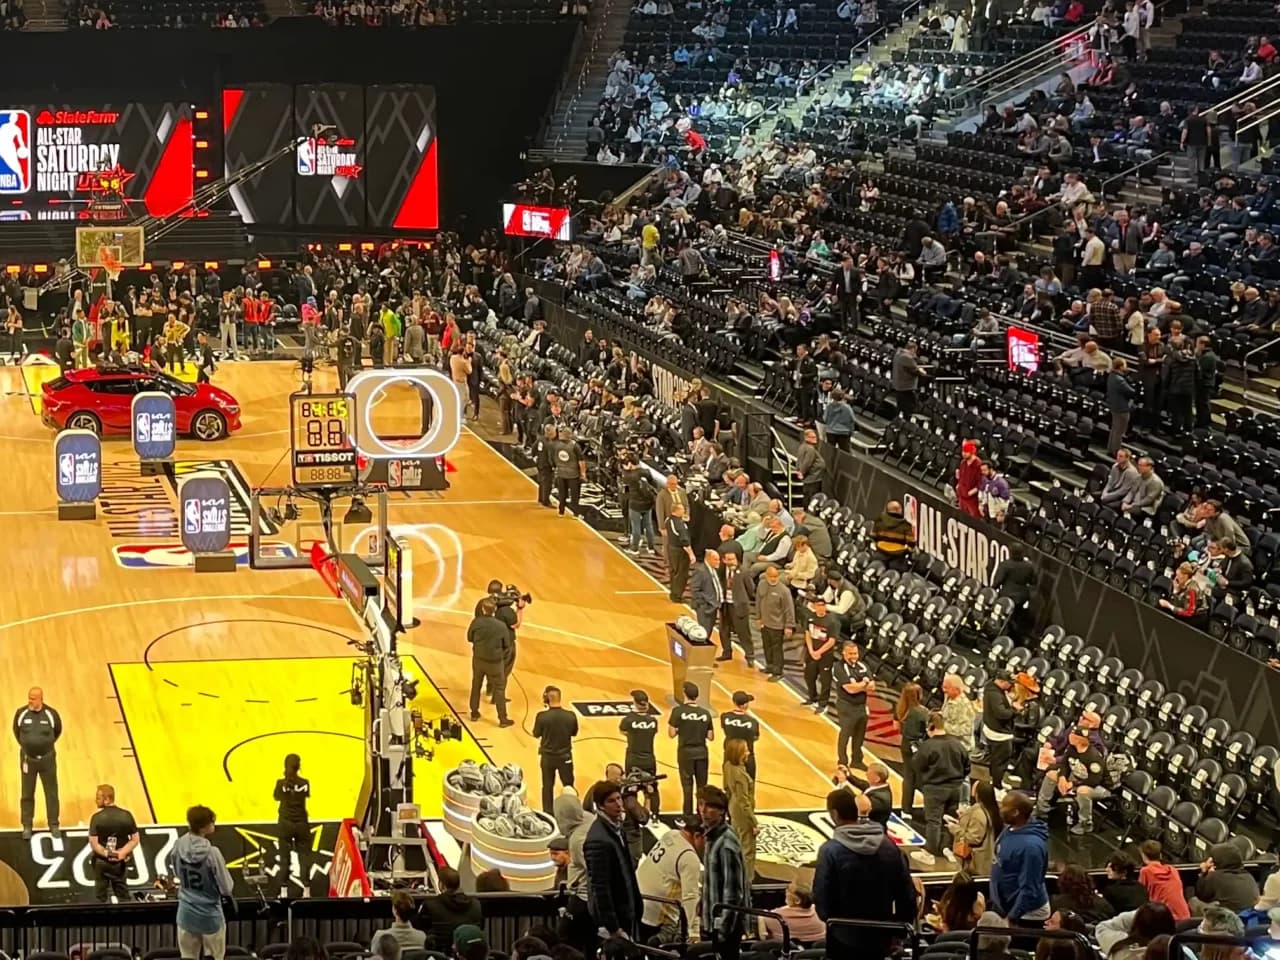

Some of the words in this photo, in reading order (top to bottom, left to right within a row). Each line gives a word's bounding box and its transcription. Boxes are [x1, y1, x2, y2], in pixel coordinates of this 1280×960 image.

[55, 111, 117, 124] StateFarm
[37, 144, 120, 172] SATURDAY
[0, 174, 18, 188] NBA
[37, 172, 78, 191] NIGHT
[314, 452, 354, 463] TISSOT
[182, 867, 203, 890] 12
